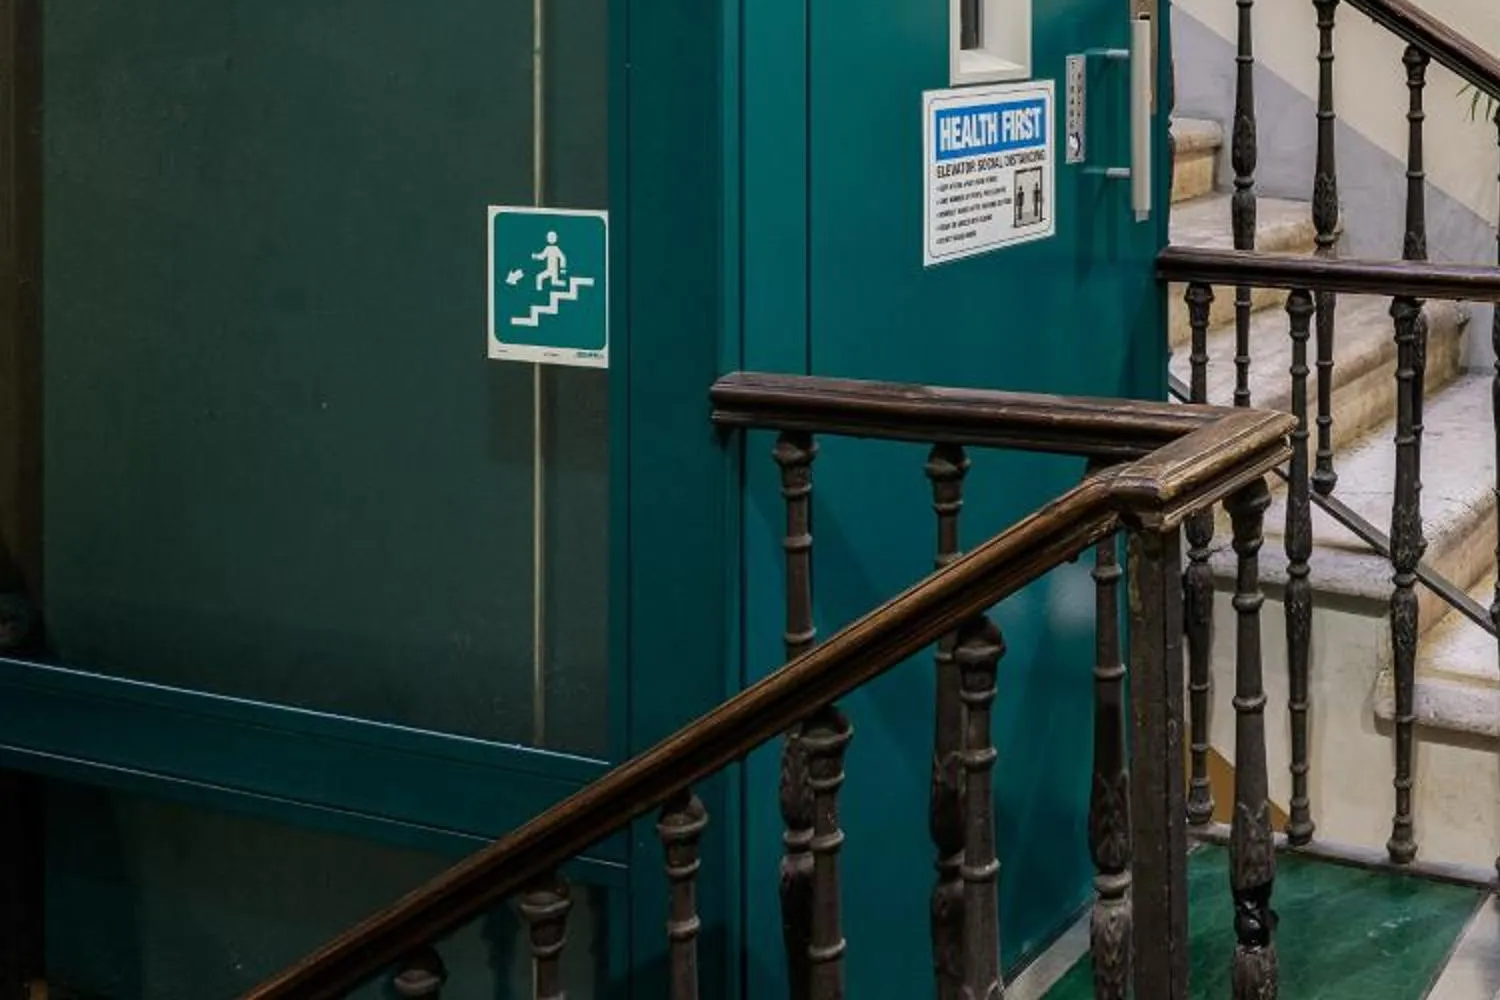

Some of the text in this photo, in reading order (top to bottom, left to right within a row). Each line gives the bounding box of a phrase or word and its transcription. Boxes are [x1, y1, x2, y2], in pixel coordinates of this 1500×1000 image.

[939, 107, 1042, 152] HEALTH FIRST
[936, 160, 976, 179] ELEVATOR
